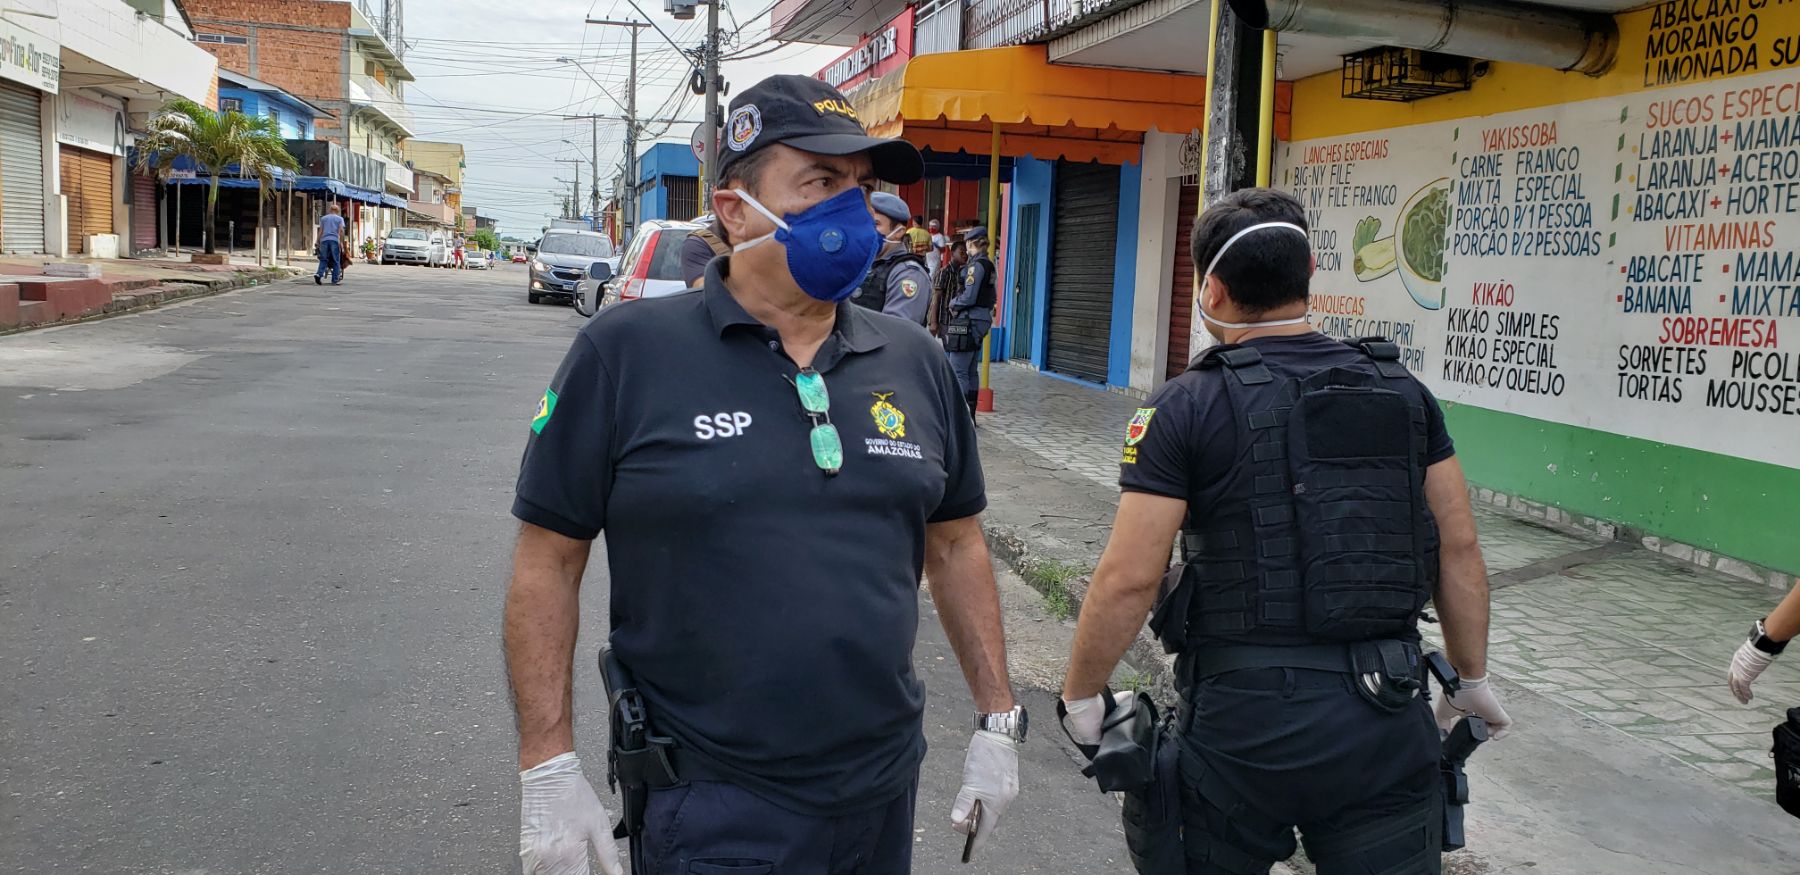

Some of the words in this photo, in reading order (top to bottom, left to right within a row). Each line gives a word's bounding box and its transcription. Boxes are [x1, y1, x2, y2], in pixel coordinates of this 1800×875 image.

[1646, 13, 1758, 59] MORANGO
[1644, 43, 1758, 87] LIMONADA
[1647, 94, 1714, 128] SUCOS
[1304, 144, 1342, 164] LANCHES
[1345, 139, 1389, 161] ESPECIAIS
[1482, 121, 1556, 152] YAKISSOBA
[1639, 124, 1718, 160] LARANJA
[1461, 154, 1503, 178] CARNE
[1516, 146, 1579, 175] FRANGO
[1636, 157, 1716, 191] LARANJA
[1730, 150, 1800, 184] ACERO
[1310, 187, 1324, 208] NY
[1353, 184, 1397, 208] FRANGO
[1458, 178, 1501, 206] MIXTA
[1515, 173, 1586, 203] ESPECIAL
[1456, 204, 1510, 234] PORÇÃO
[1538, 202, 1592, 229] PESSOA
[1453, 229, 1508, 257] PORÇÃO
[1535, 230, 1602, 256] PESSOAS
[1665, 221, 1776, 252] VITAMINAS
[1315, 252, 1341, 271] ACON
[1627, 253, 1704, 283] ABACATE
[1472, 278, 1515, 307] KIKÃO
[1623, 285, 1692, 314] BANANA
[1322, 315, 1353, 338] CARNE
[1447, 306, 1489, 334] KIKÃO
[1496, 311, 1559, 340] SIMPLES
[1658, 316, 1777, 349] SOBREMESA
[1445, 334, 1487, 360] KIKÃO
[1492, 338, 1557, 369] ESPECIAL
[1617, 344, 1707, 375] SORVETES
[1443, 359, 1485, 386] KIKÃO
[1506, 367, 1565, 397] QUEIJO
[1618, 372, 1683, 404] TORTAS
[694, 412, 753, 440] SSP
[865, 438, 888, 446] GOVERNO
[868, 445, 923, 459] AMAZONAS
